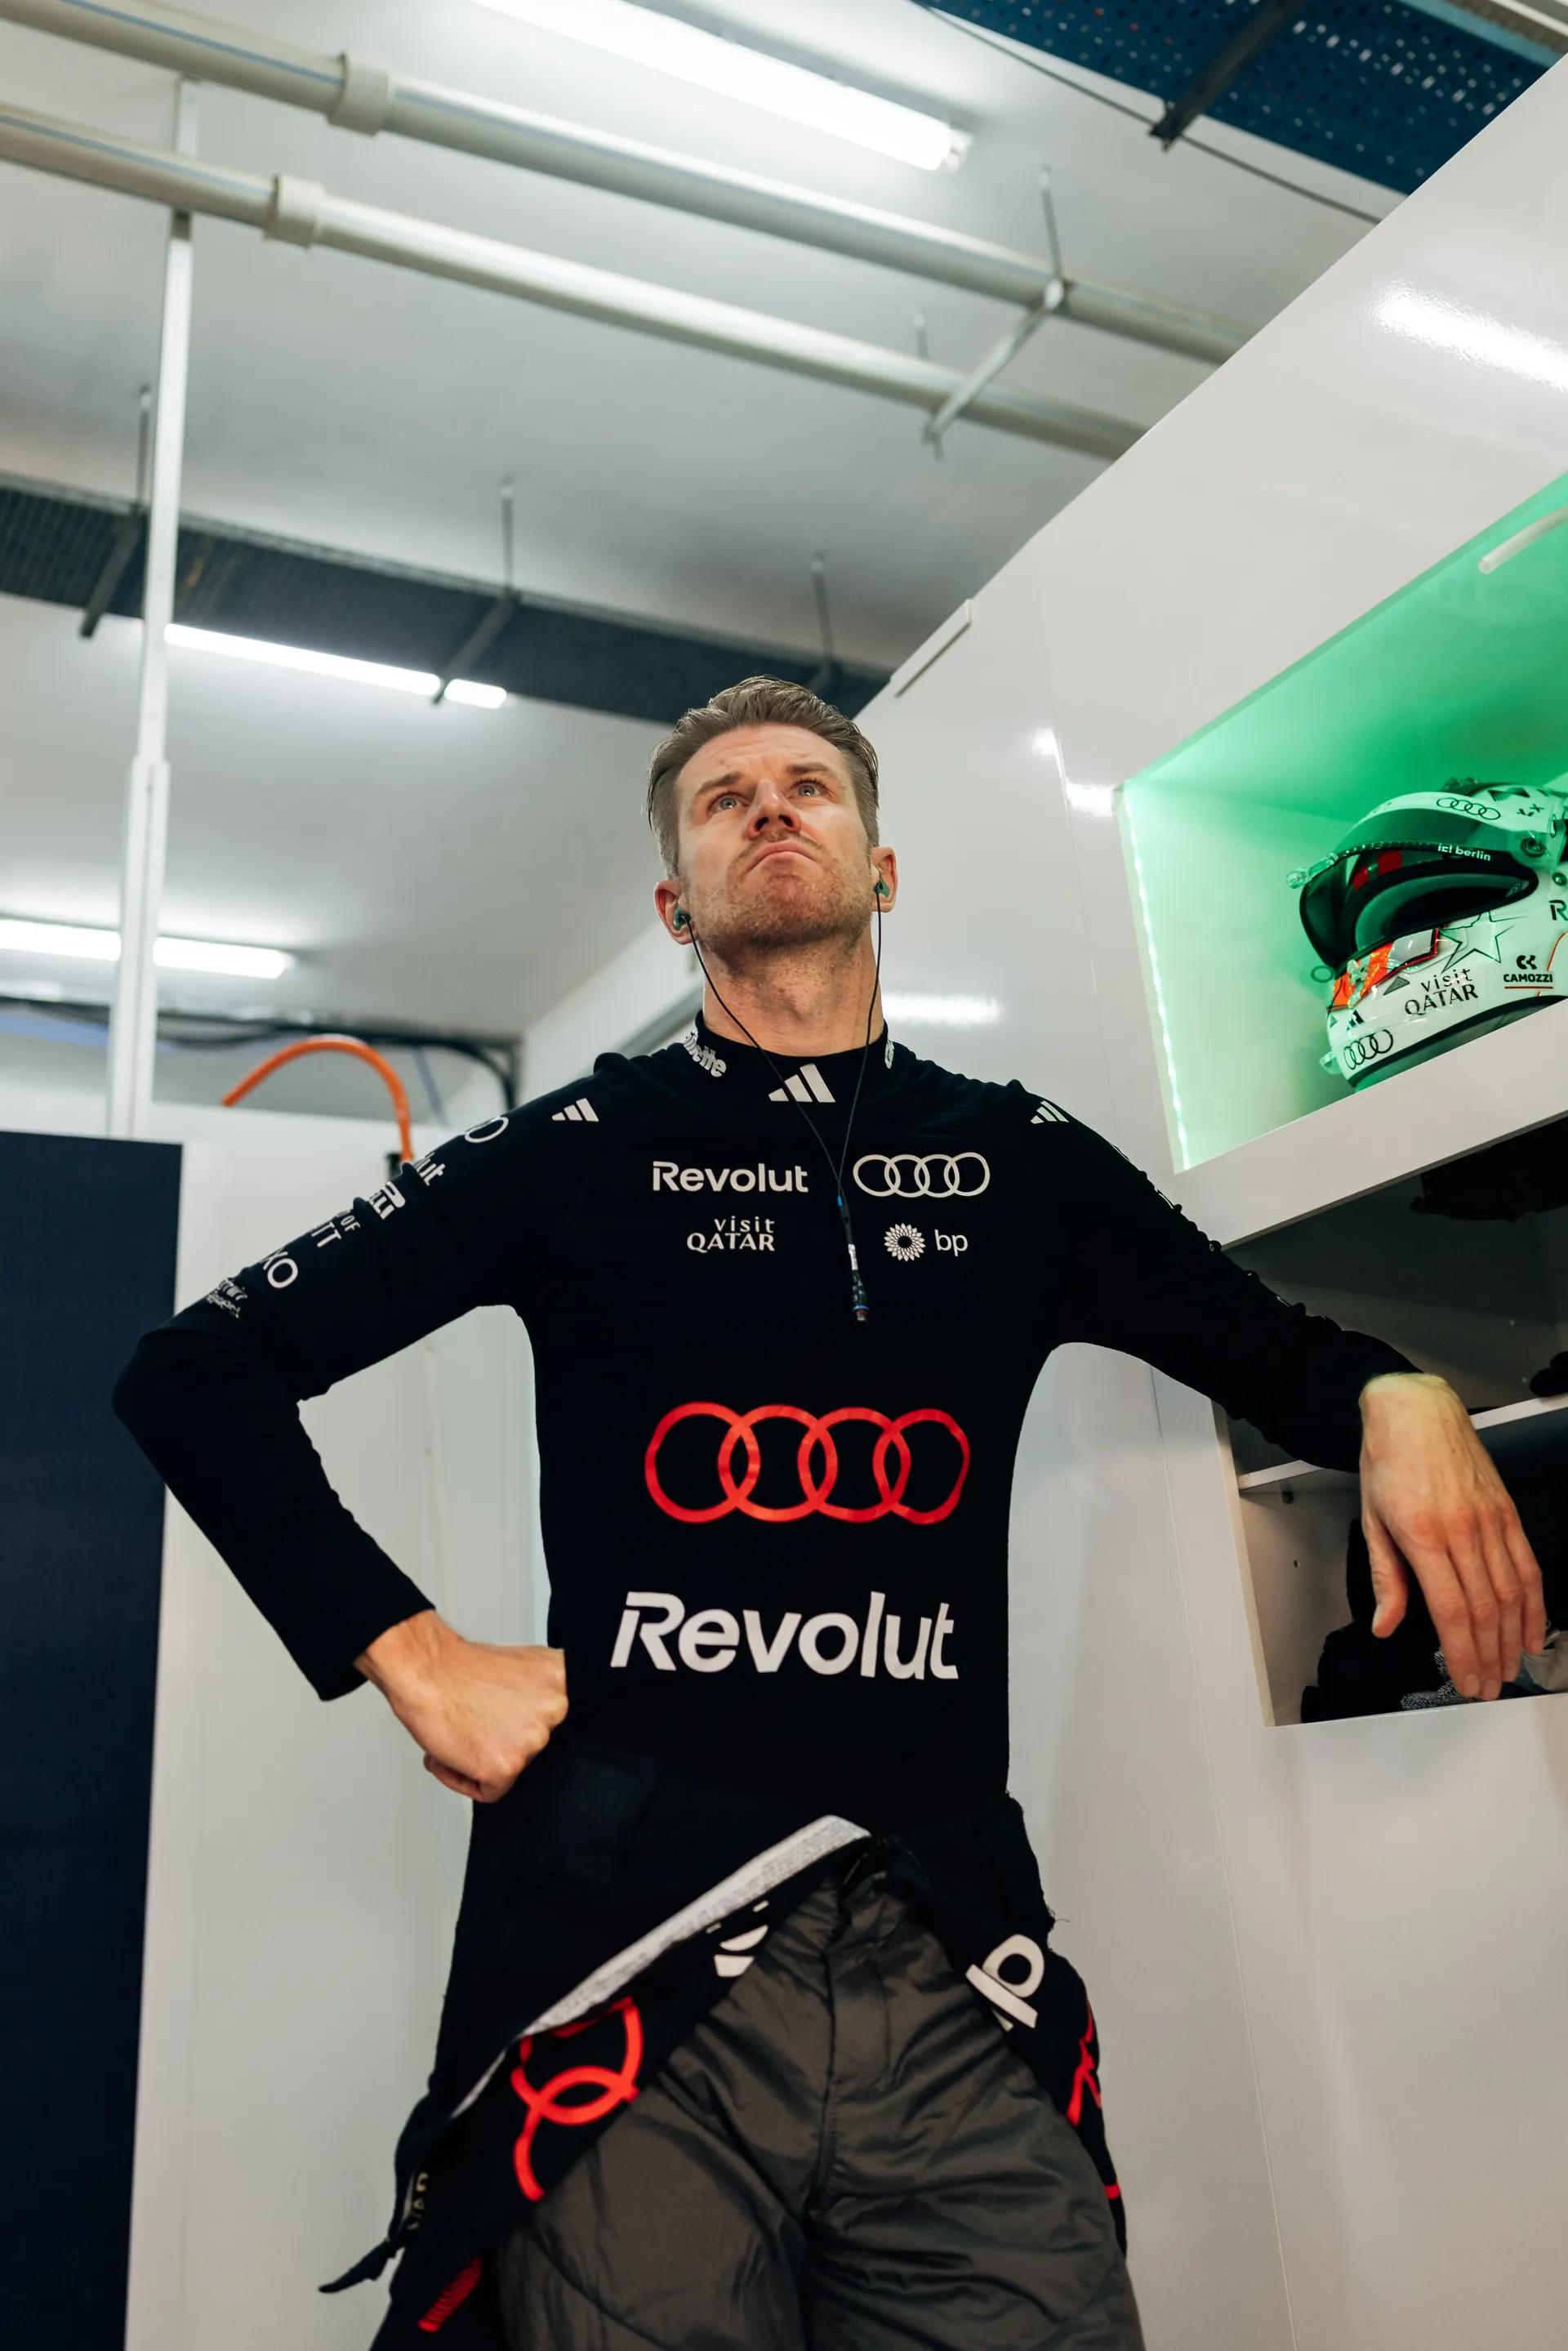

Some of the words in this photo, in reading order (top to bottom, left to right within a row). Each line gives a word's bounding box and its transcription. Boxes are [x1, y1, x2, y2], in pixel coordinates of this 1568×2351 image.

[1454, 845, 1491, 862] berlin
[1420, 968, 1473, 993] visit
[1503, 973, 1553, 983] CAMOZZI
[1405, 984, 1479, 1016] QATAR
[653, 1161, 808, 1193] Revolut
[714, 1216, 775, 1233] visit
[687, 1232, 775, 1254] QATAR
[934, 1229, 969, 1257] bp
[610, 1590, 959, 1680] Revolut
